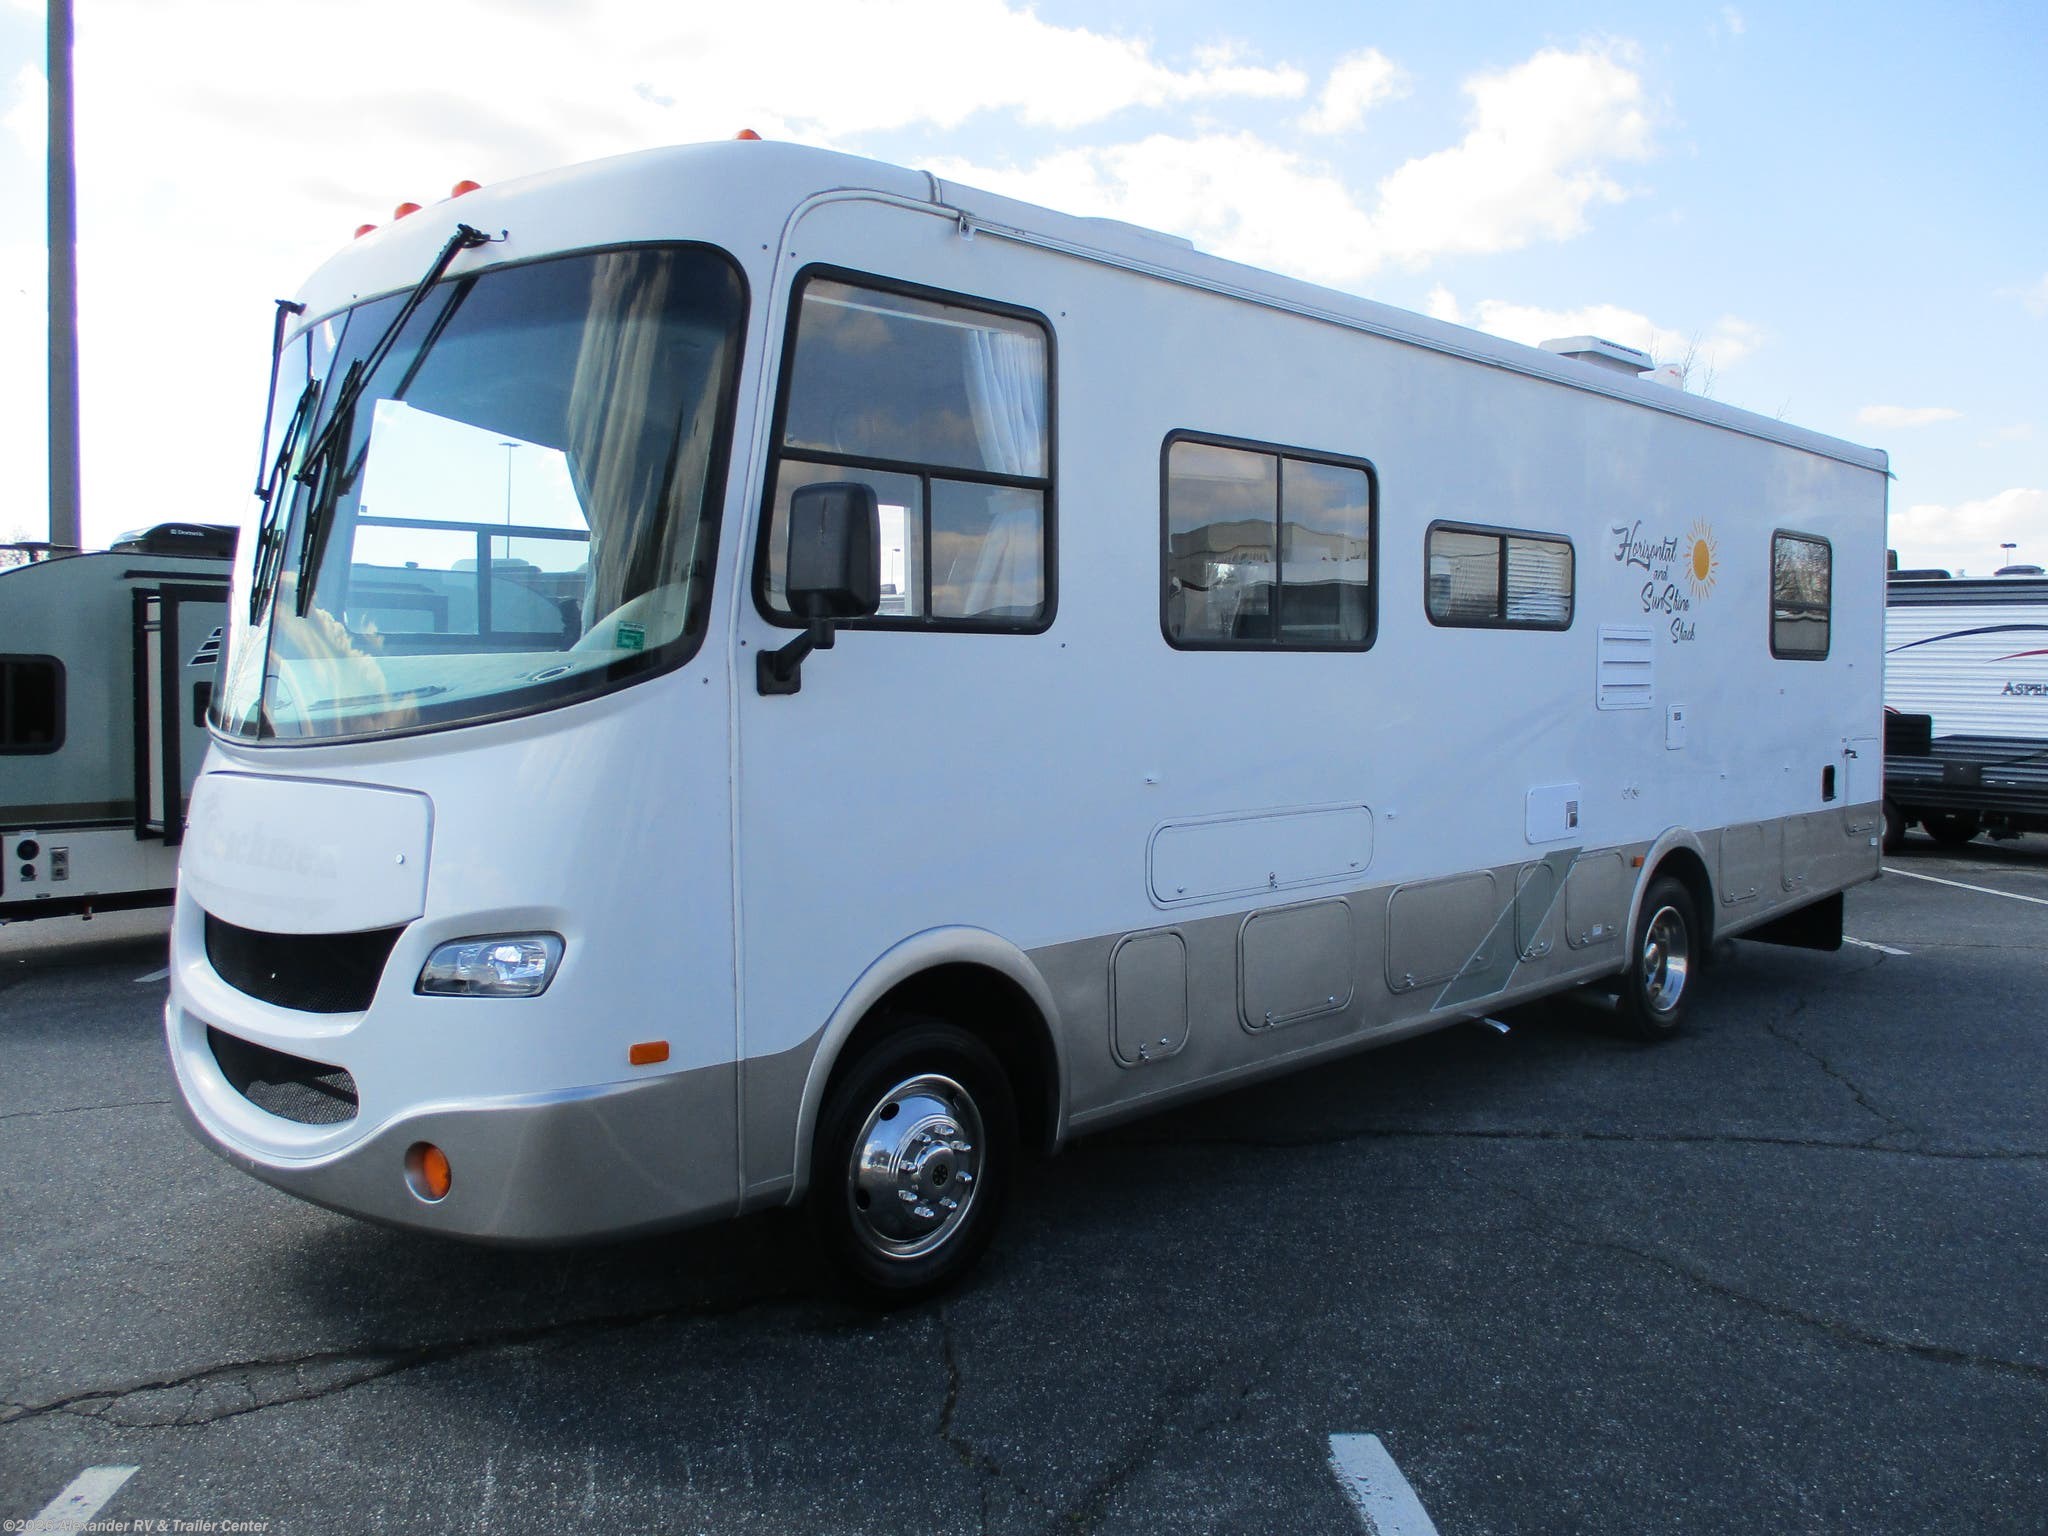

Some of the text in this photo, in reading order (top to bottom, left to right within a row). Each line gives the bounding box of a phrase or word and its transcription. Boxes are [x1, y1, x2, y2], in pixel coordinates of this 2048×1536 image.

[1612, 519, 1677, 571] Horizontal
[1653, 565, 1669, 581] and
[1670, 617, 1696, 644] Shack
